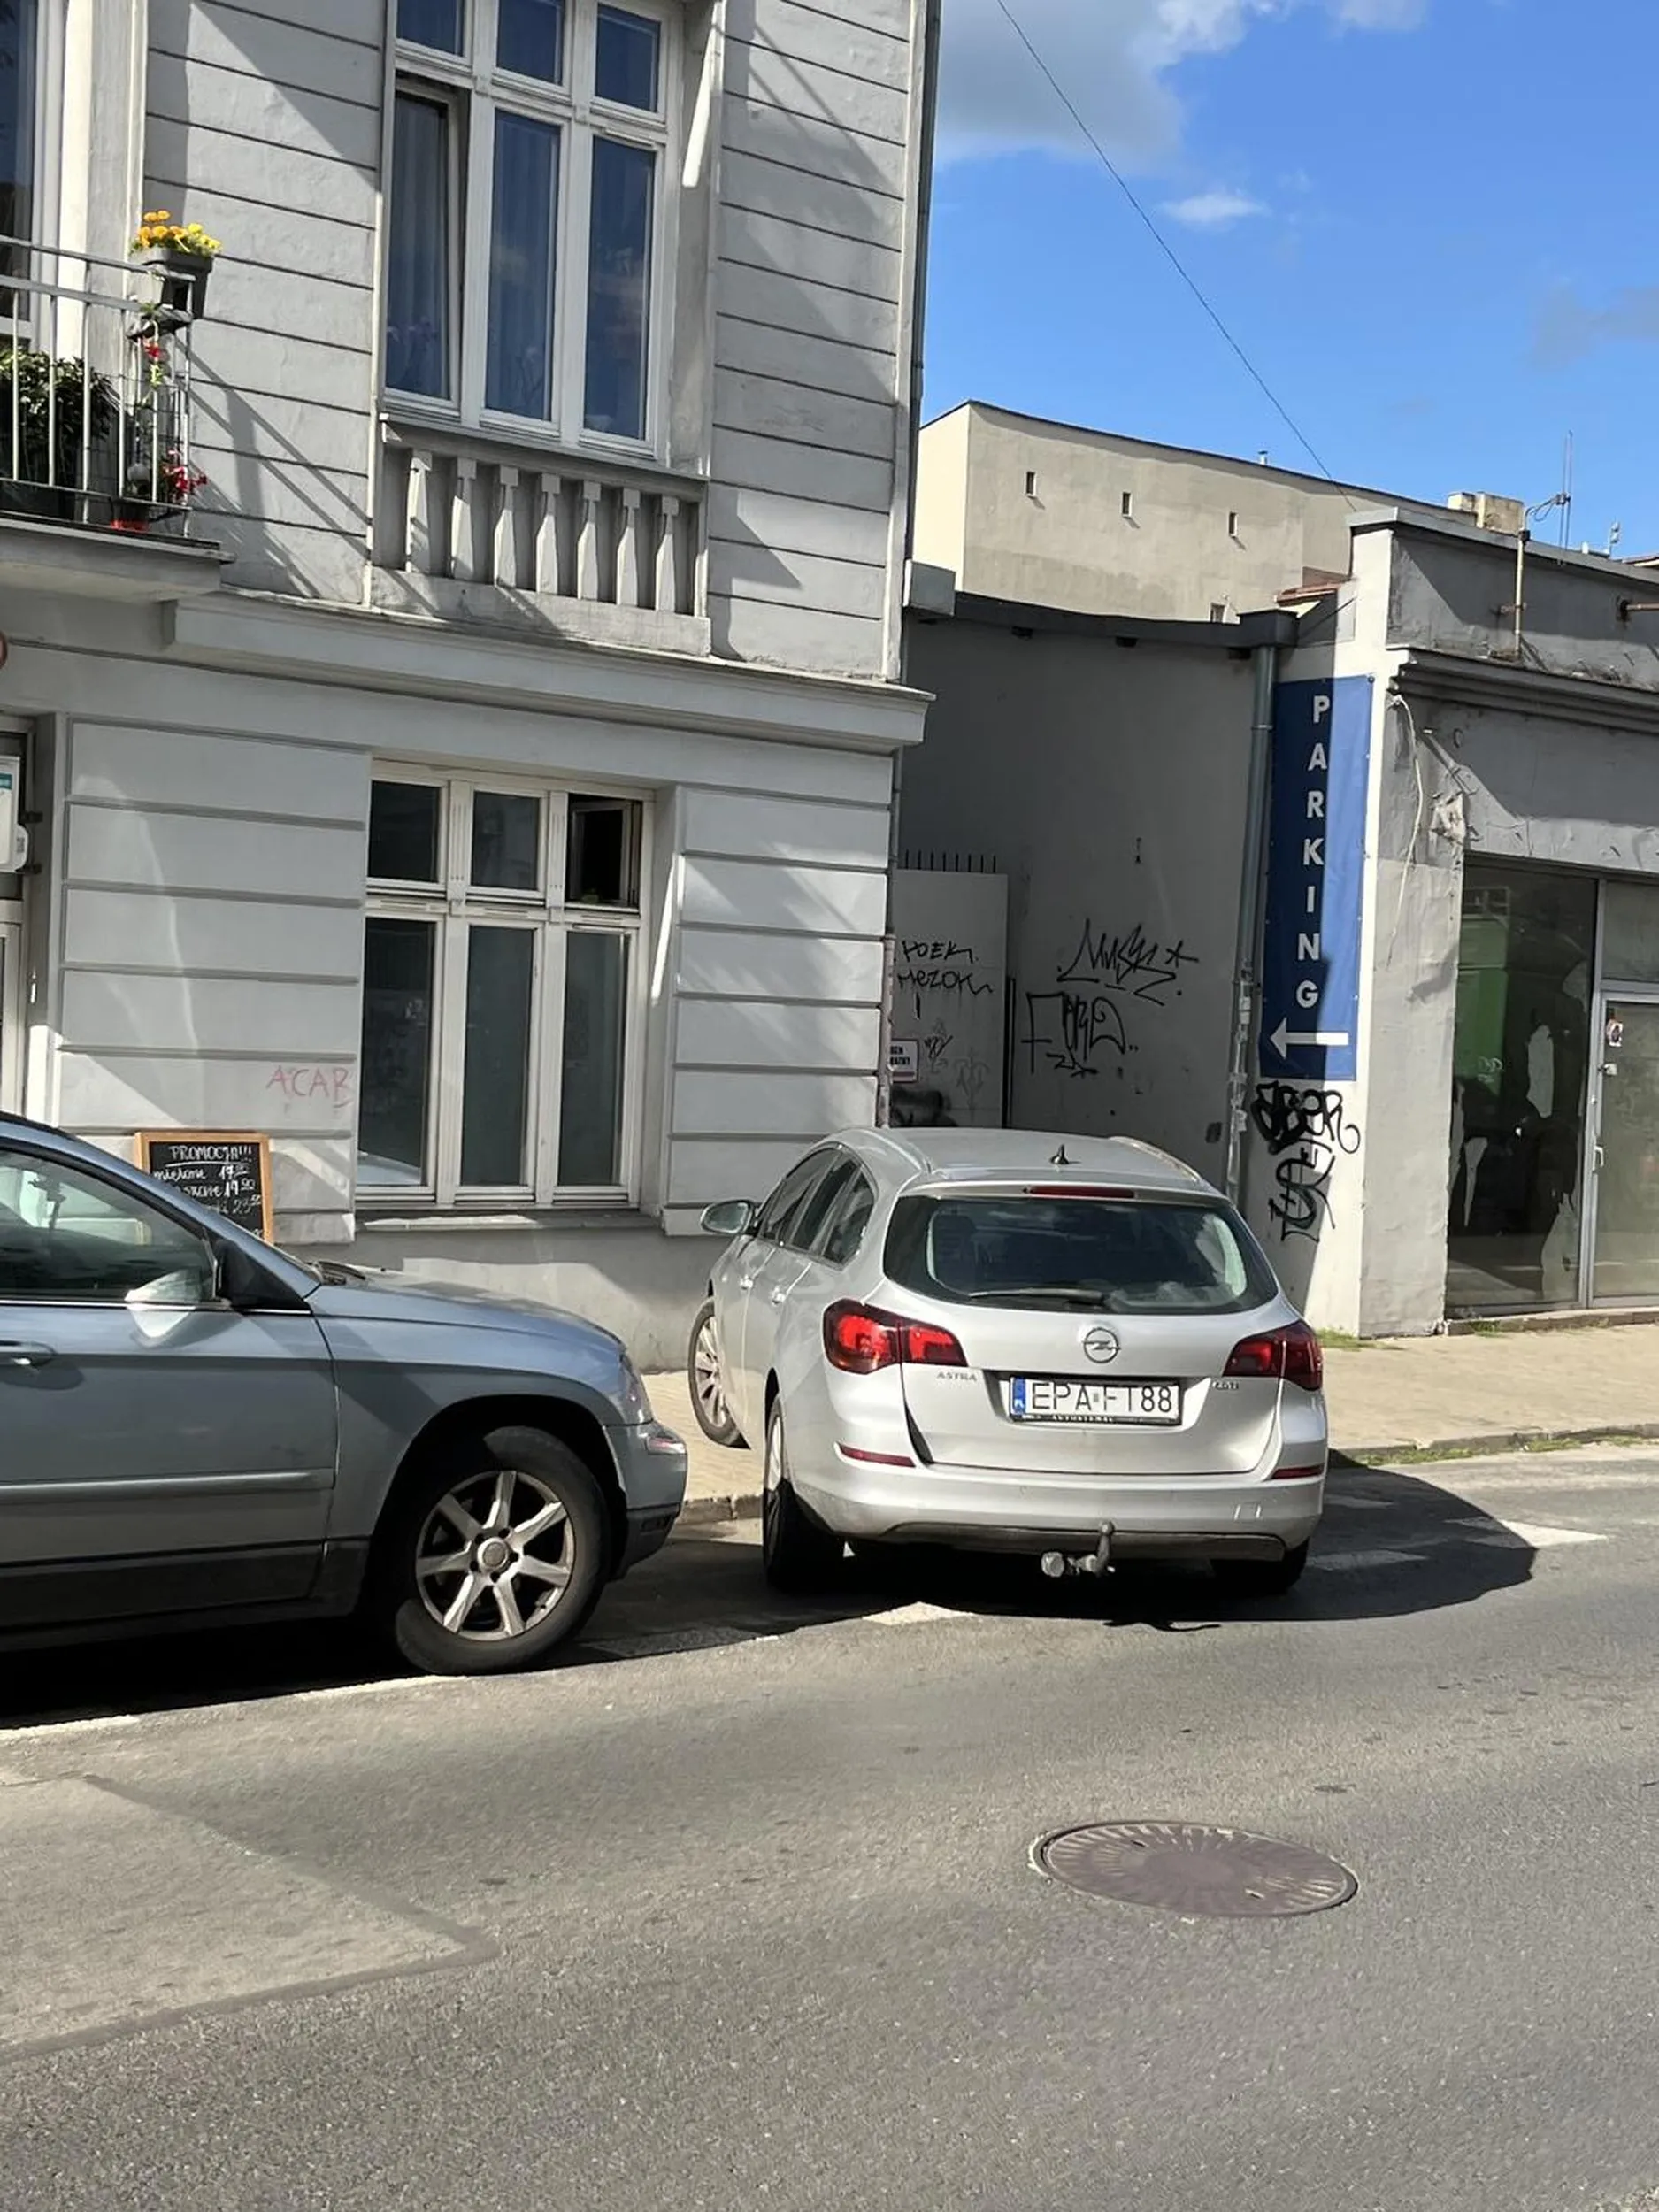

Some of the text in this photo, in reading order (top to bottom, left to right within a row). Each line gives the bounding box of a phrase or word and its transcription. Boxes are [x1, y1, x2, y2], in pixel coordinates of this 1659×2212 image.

[1295, 695, 1331, 1009] PARKING
[936, 1371, 978, 1382] ASTRA
[1032, 1382, 1093, 1411] EPA
